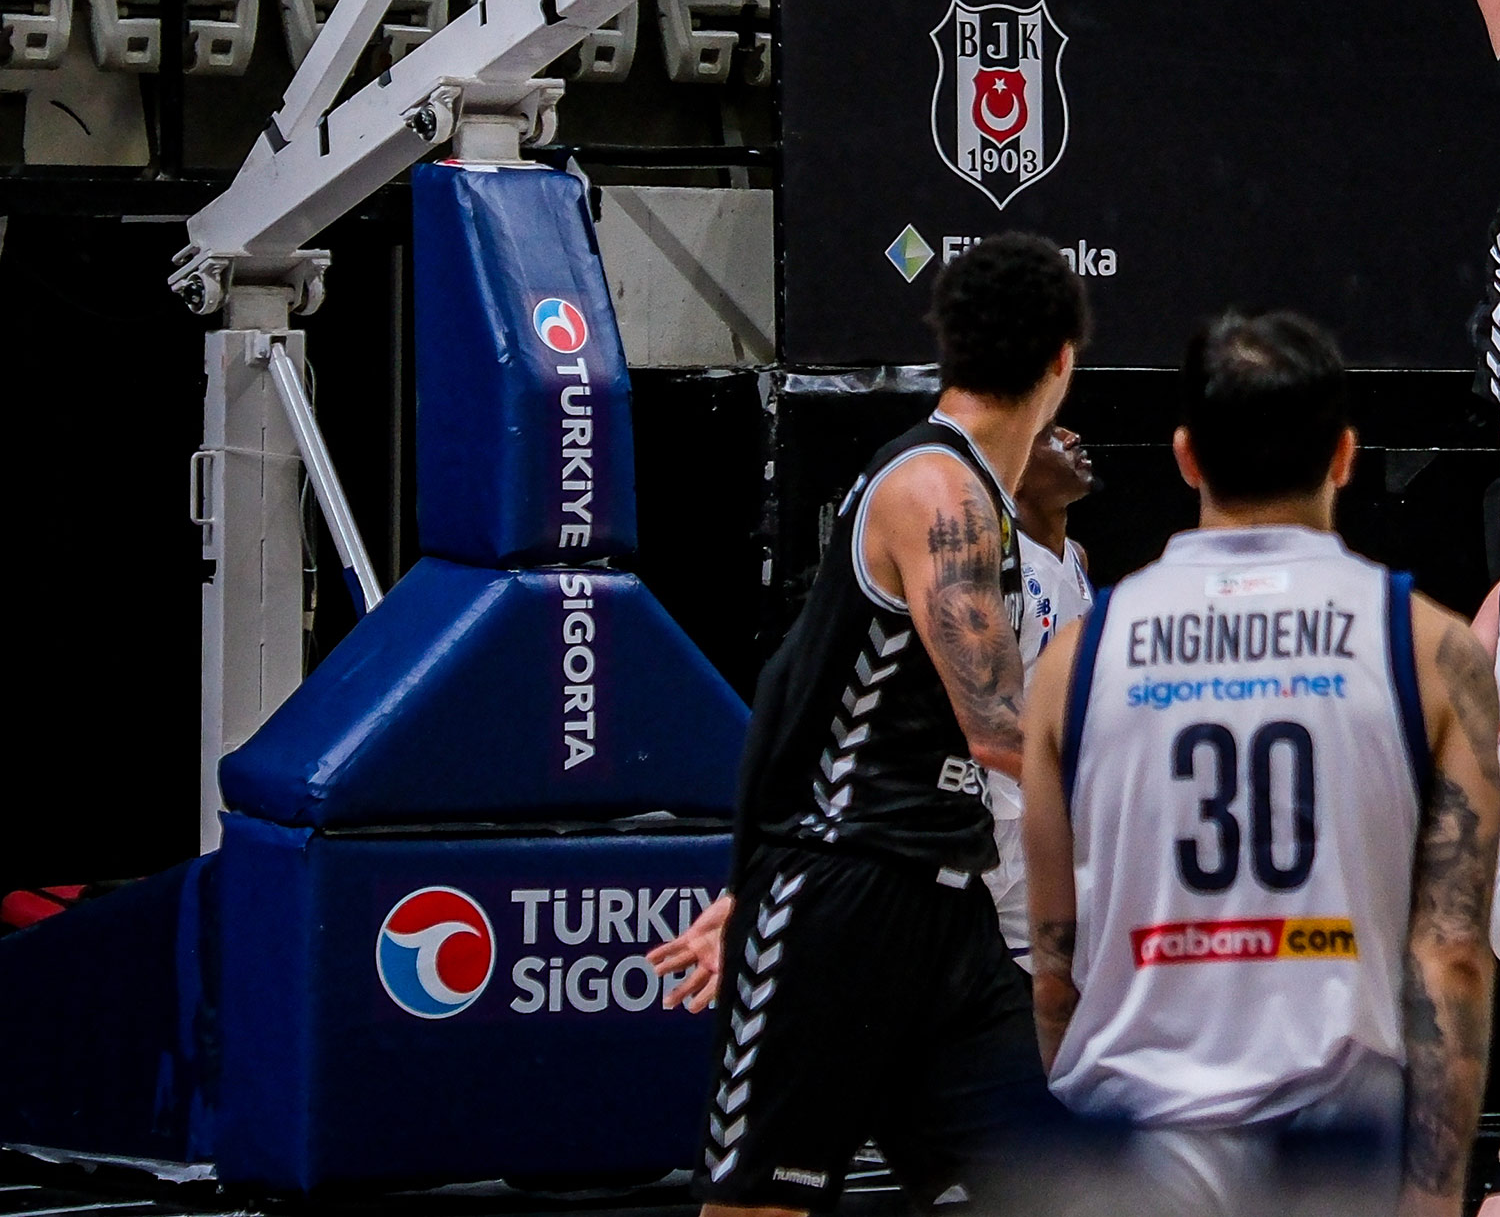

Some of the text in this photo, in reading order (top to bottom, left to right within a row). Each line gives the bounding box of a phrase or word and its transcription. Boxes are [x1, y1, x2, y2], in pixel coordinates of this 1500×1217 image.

[958, 21, 1041, 60] BJK
[966, 147, 1038, 174] 1903
[556, 357, 596, 771] TÜRKİYE SİGORTA
[1127, 600, 1356, 668] ENGİNDENİZ
[1126, 672, 1347, 711] sigortam.net
[1171, 721, 1318, 893] 30
[772, 1167, 826, 1189] hummel
